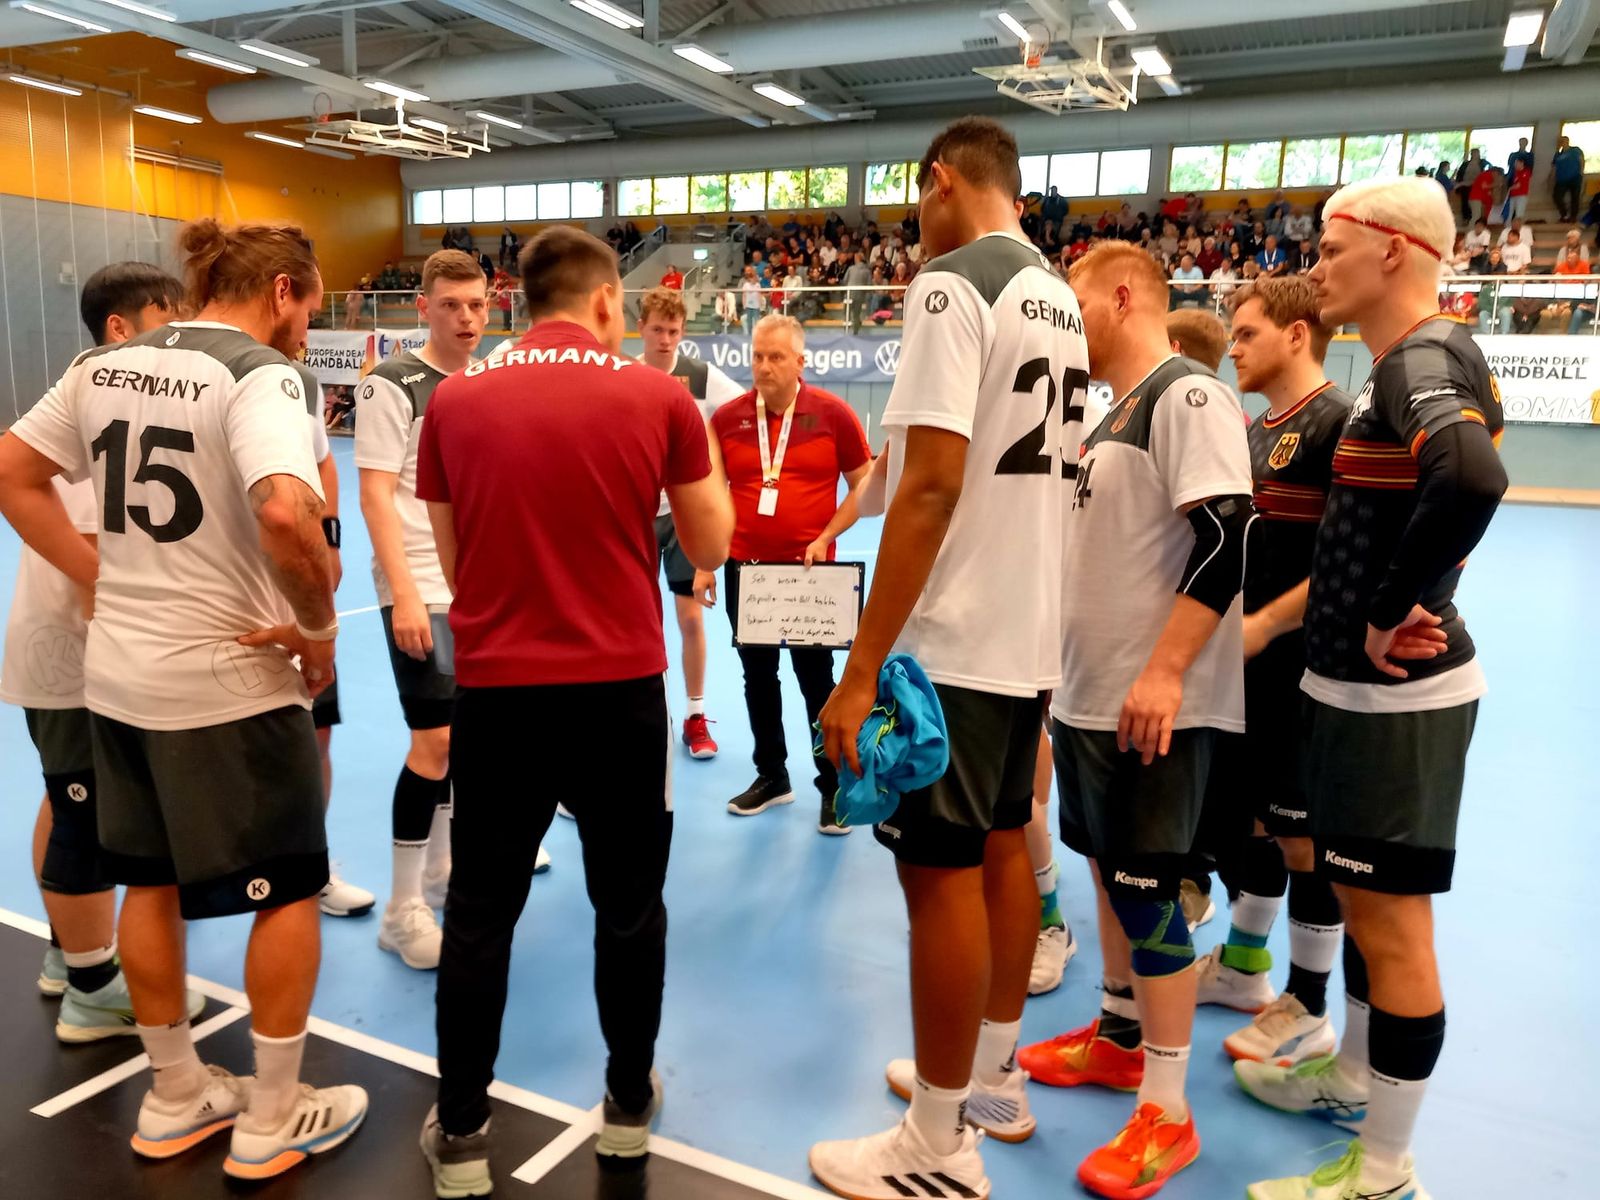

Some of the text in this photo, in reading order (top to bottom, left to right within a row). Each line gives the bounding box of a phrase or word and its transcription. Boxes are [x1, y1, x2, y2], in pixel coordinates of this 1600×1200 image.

[304, 348, 345, 357] EUROPEAN
[463, 348, 632, 377] GERMANY
[712, 343, 862, 375] Volagen
[1552, 356, 1589, 365] DEAF
[1491, 366, 1587, 379] ANDBALL
[91, 419, 204, 543] 15
[1269, 803, 1308, 820] Kempa
[1325, 849, 1374, 874] Kempa
[1114, 870, 1159, 890] Kempa
